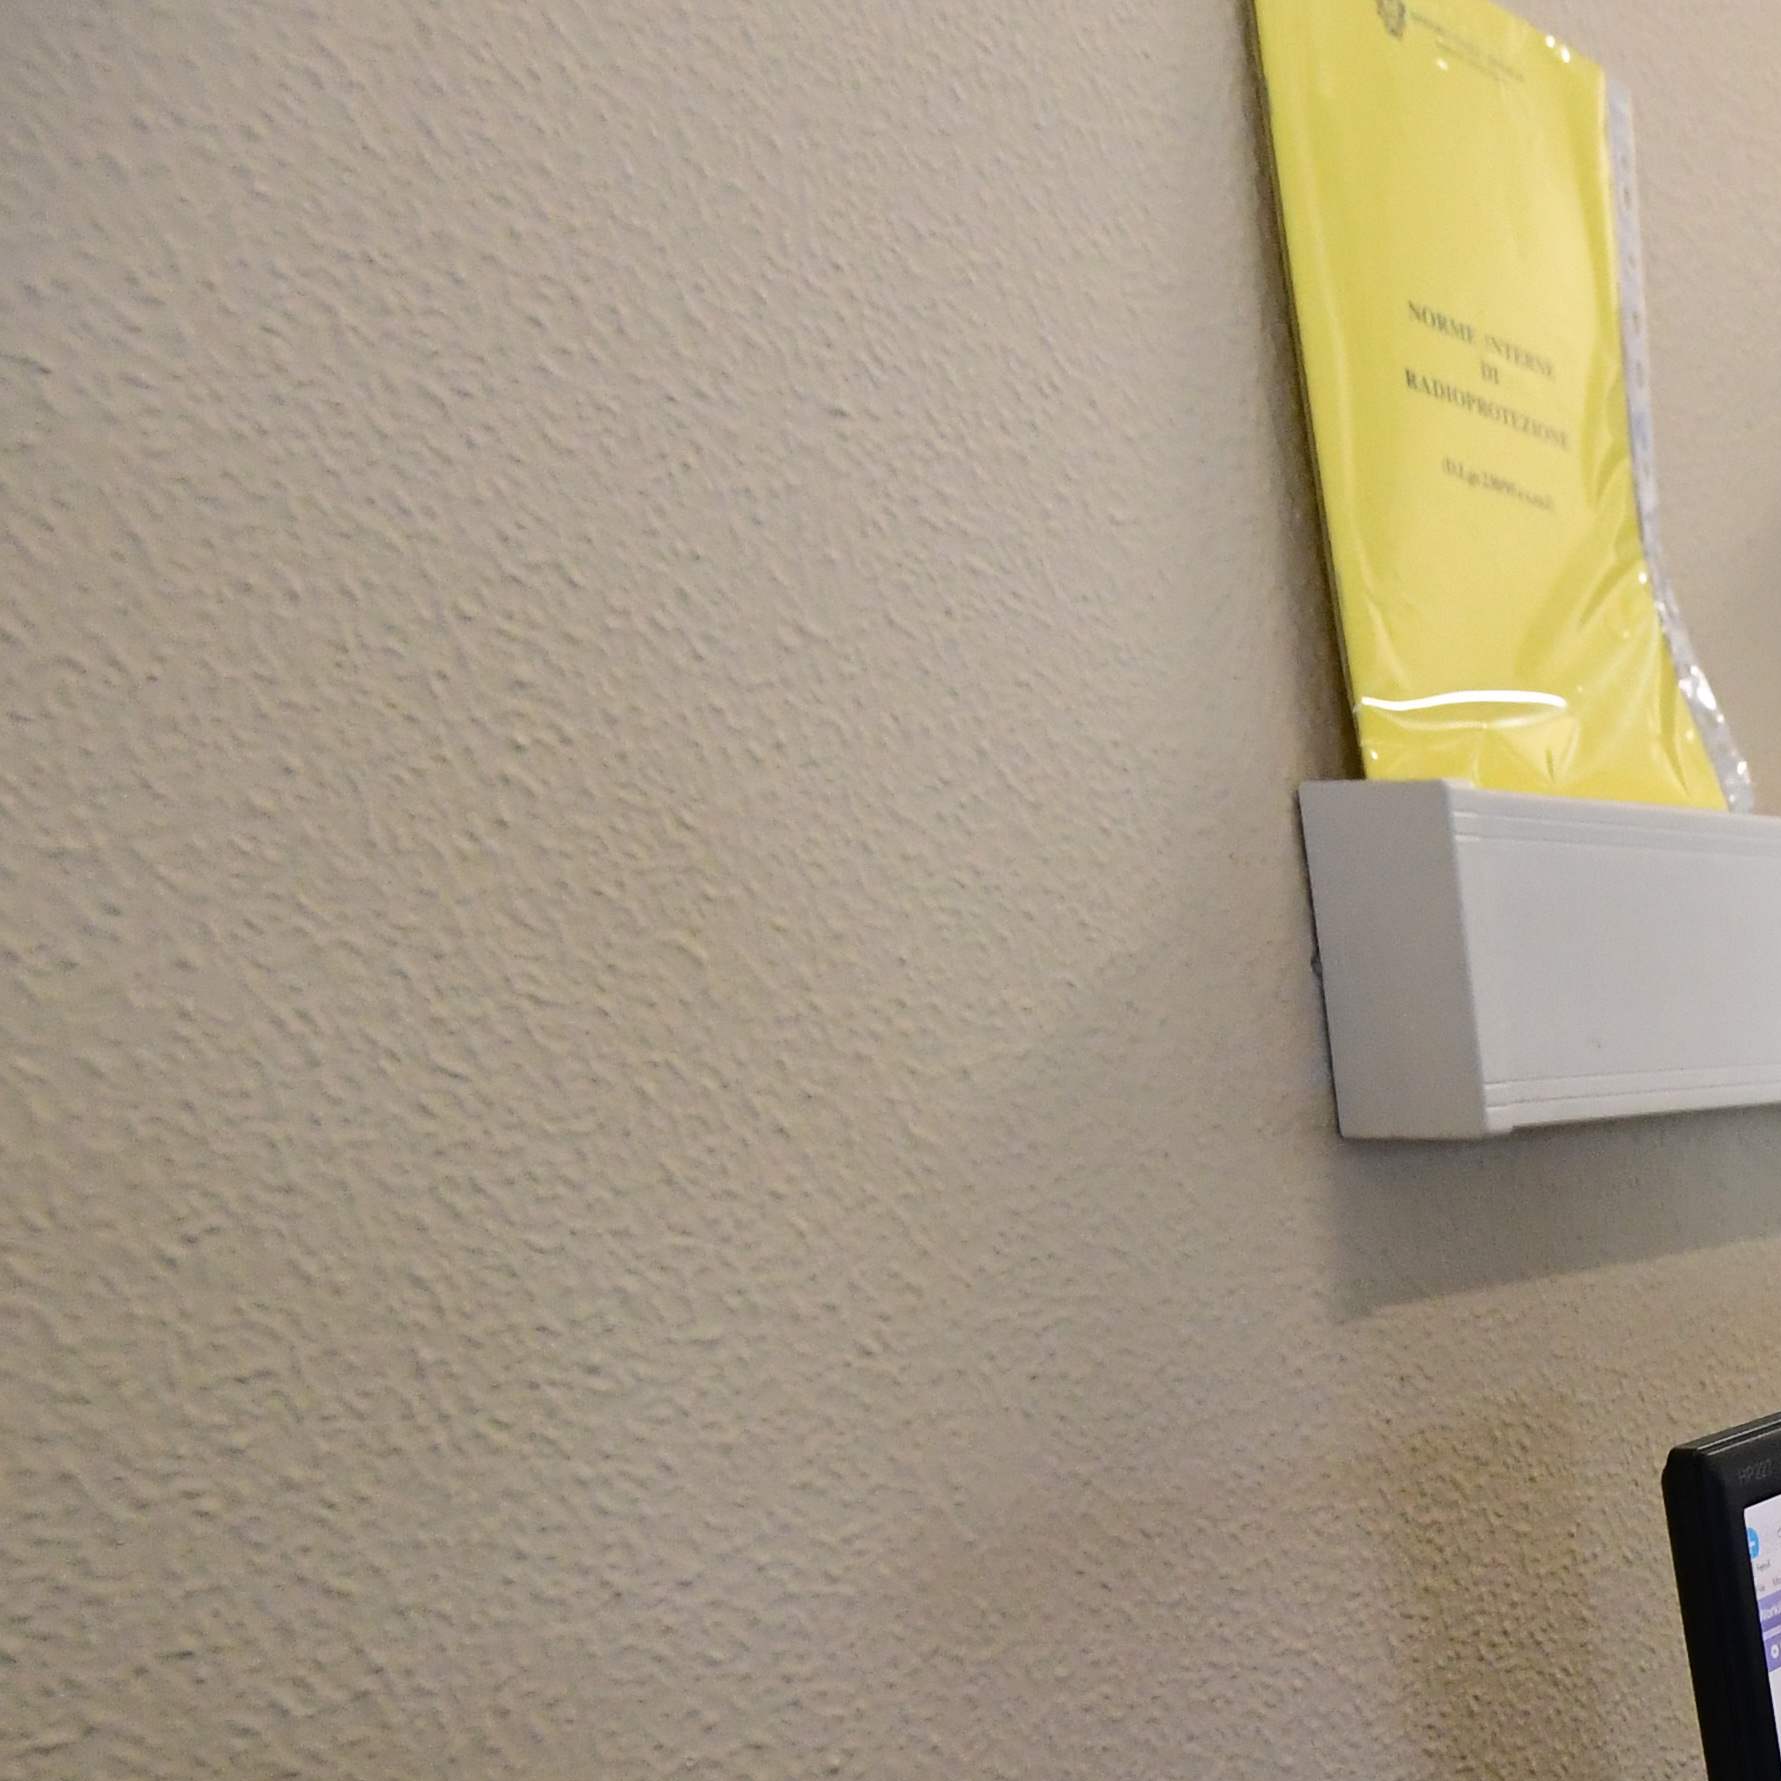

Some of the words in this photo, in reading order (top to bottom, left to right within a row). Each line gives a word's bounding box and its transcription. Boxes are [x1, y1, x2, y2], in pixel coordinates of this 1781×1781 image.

[1406, 299, 1476, 346] NORME
[1484, 334, 1556, 382] INTERNE
[1480, 360, 1500, 385] DI
[1404, 367, 1569, 451] RADIOPROTEZIONE
